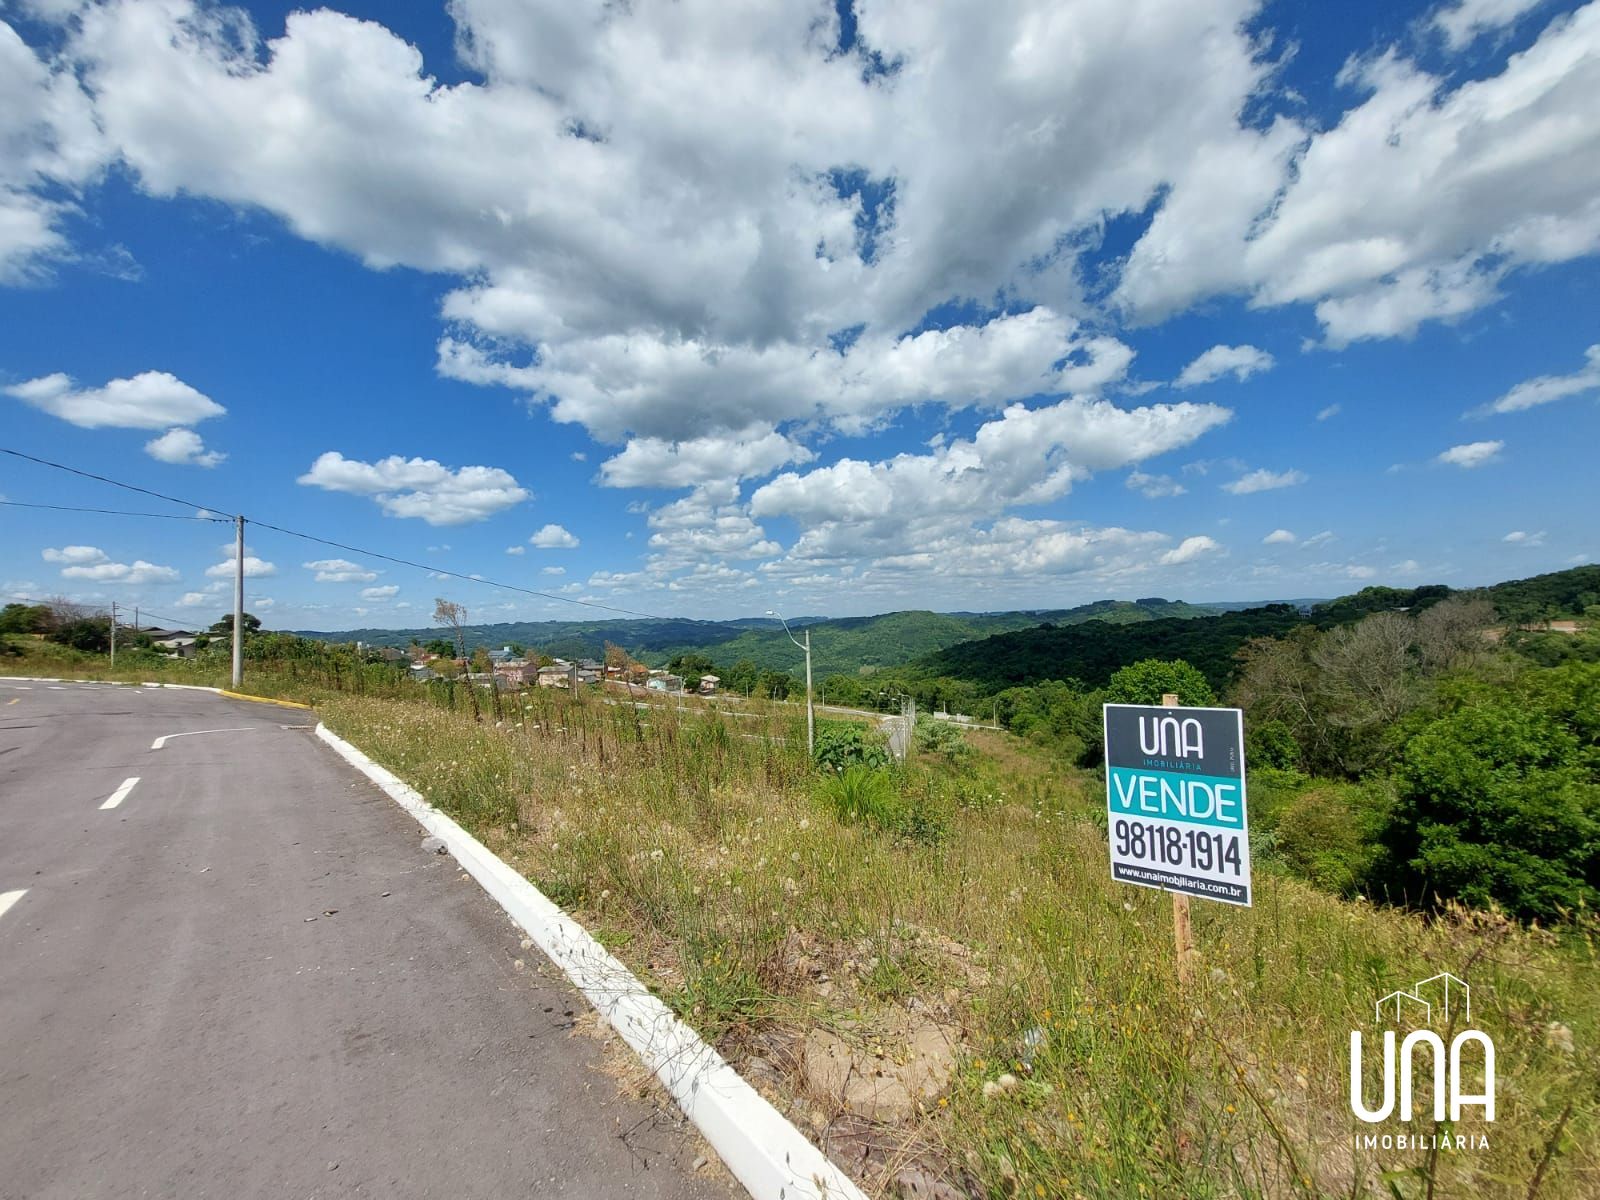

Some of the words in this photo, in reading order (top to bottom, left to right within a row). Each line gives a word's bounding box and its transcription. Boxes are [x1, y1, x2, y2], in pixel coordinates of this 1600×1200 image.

[1139, 716, 1204, 759] UNA
[1143, 758, 1202, 770] IMOBILIÁRIA
[1113, 773, 1238, 823] VENDE
[1118, 866, 1242, 897] www.unaimobiliaria.com.br
